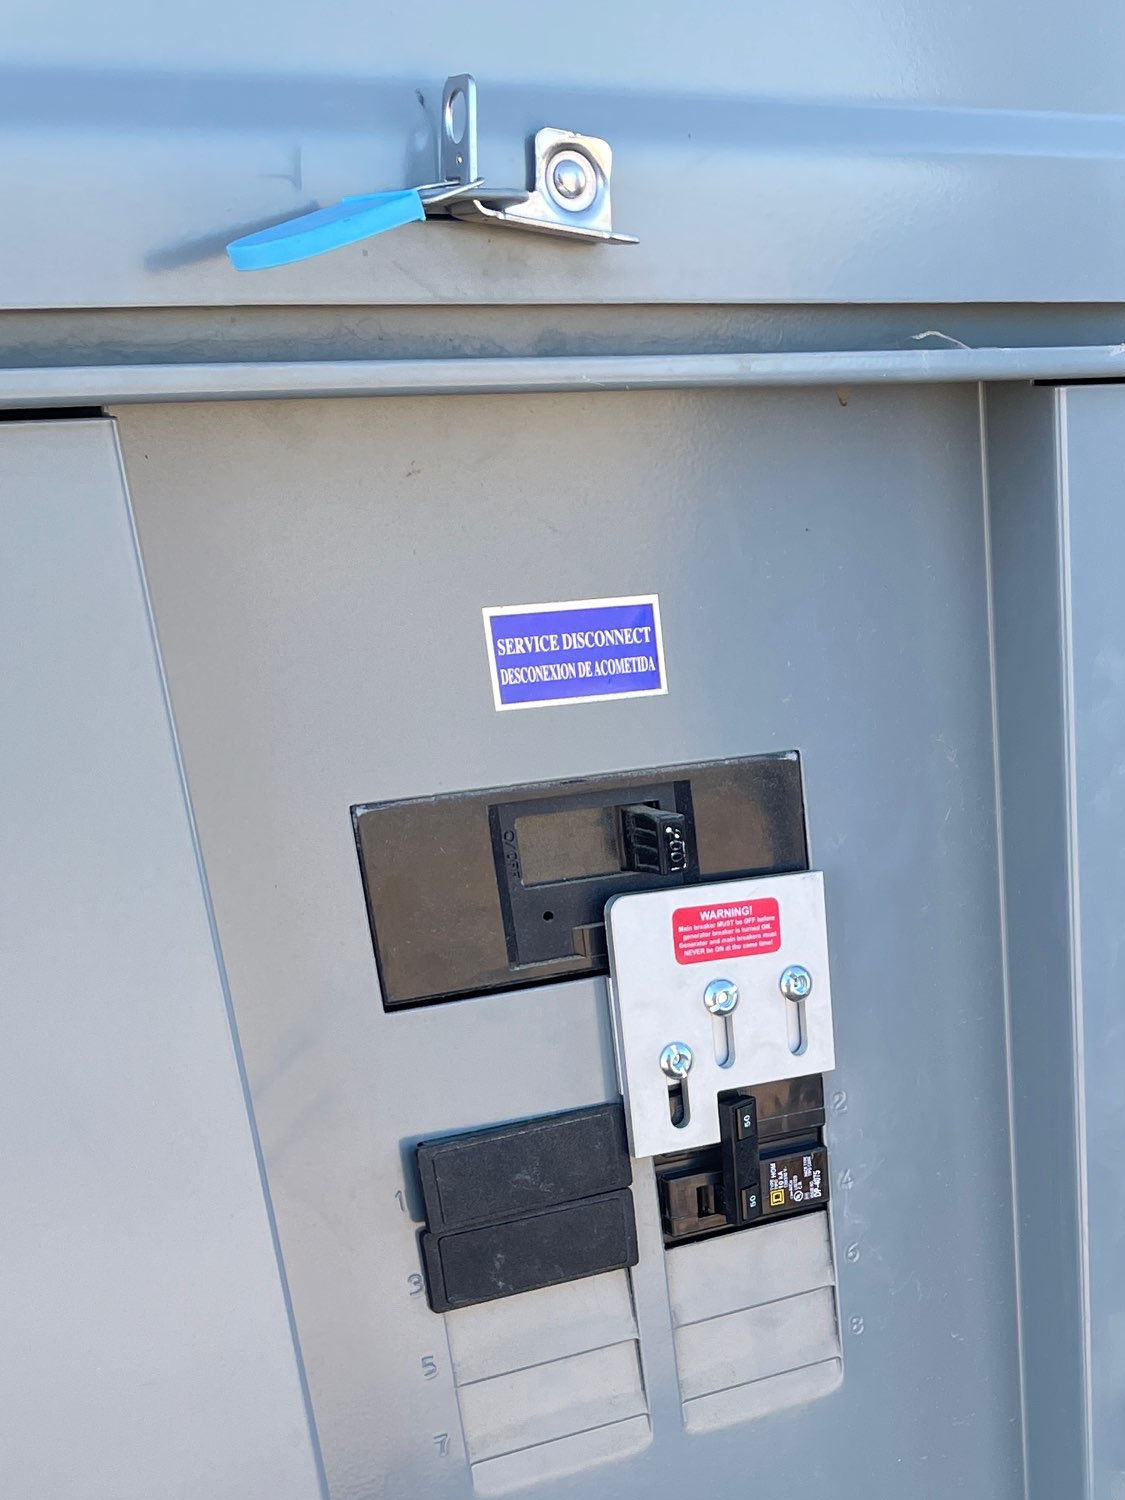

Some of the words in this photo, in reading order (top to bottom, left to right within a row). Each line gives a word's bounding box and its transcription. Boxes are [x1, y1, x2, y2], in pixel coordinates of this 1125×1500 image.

[497, 634, 559, 655] SERVICE
[562, 627, 650, 651] DISCONNECT
[501, 663, 576, 686] DESCONEXION
[579, 662, 592, 677] DE
[594, 655, 656, 676] ACOMETIDA
[700, 906, 752, 921] WARNING!
[744, 1115, 750, 1128] 50
[407, 1273, 423, 1296] 3
[420, 1355, 438, 1380] 5
